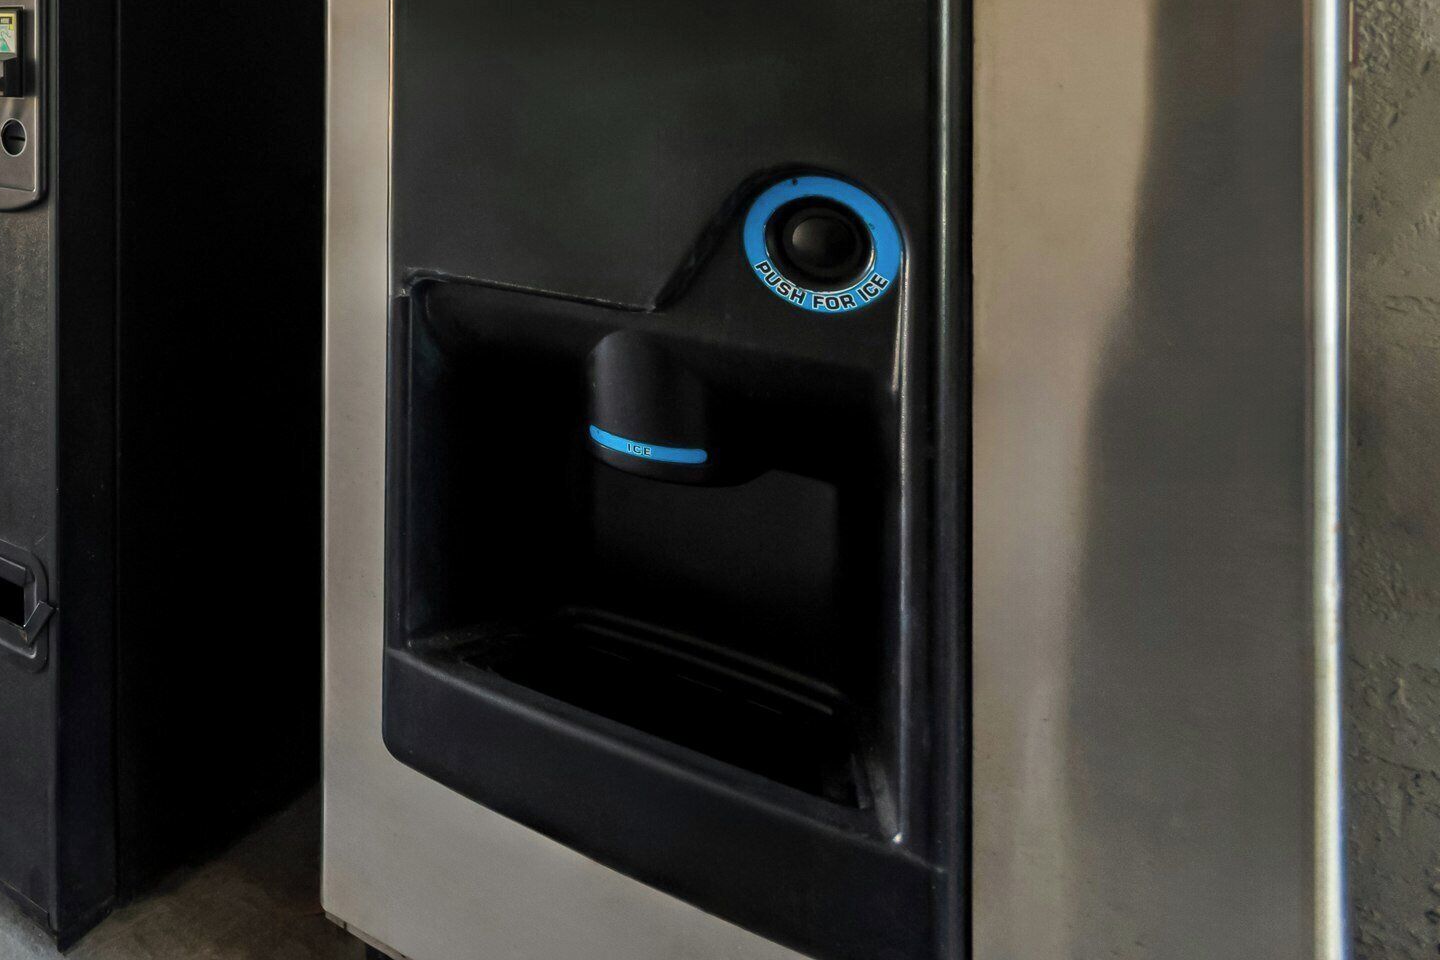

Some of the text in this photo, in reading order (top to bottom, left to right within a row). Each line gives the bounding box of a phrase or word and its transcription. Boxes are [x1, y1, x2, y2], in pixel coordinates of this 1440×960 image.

[754, 259, 890, 311] PUSH FOR ICE
[626, 443, 652, 456] ICE
